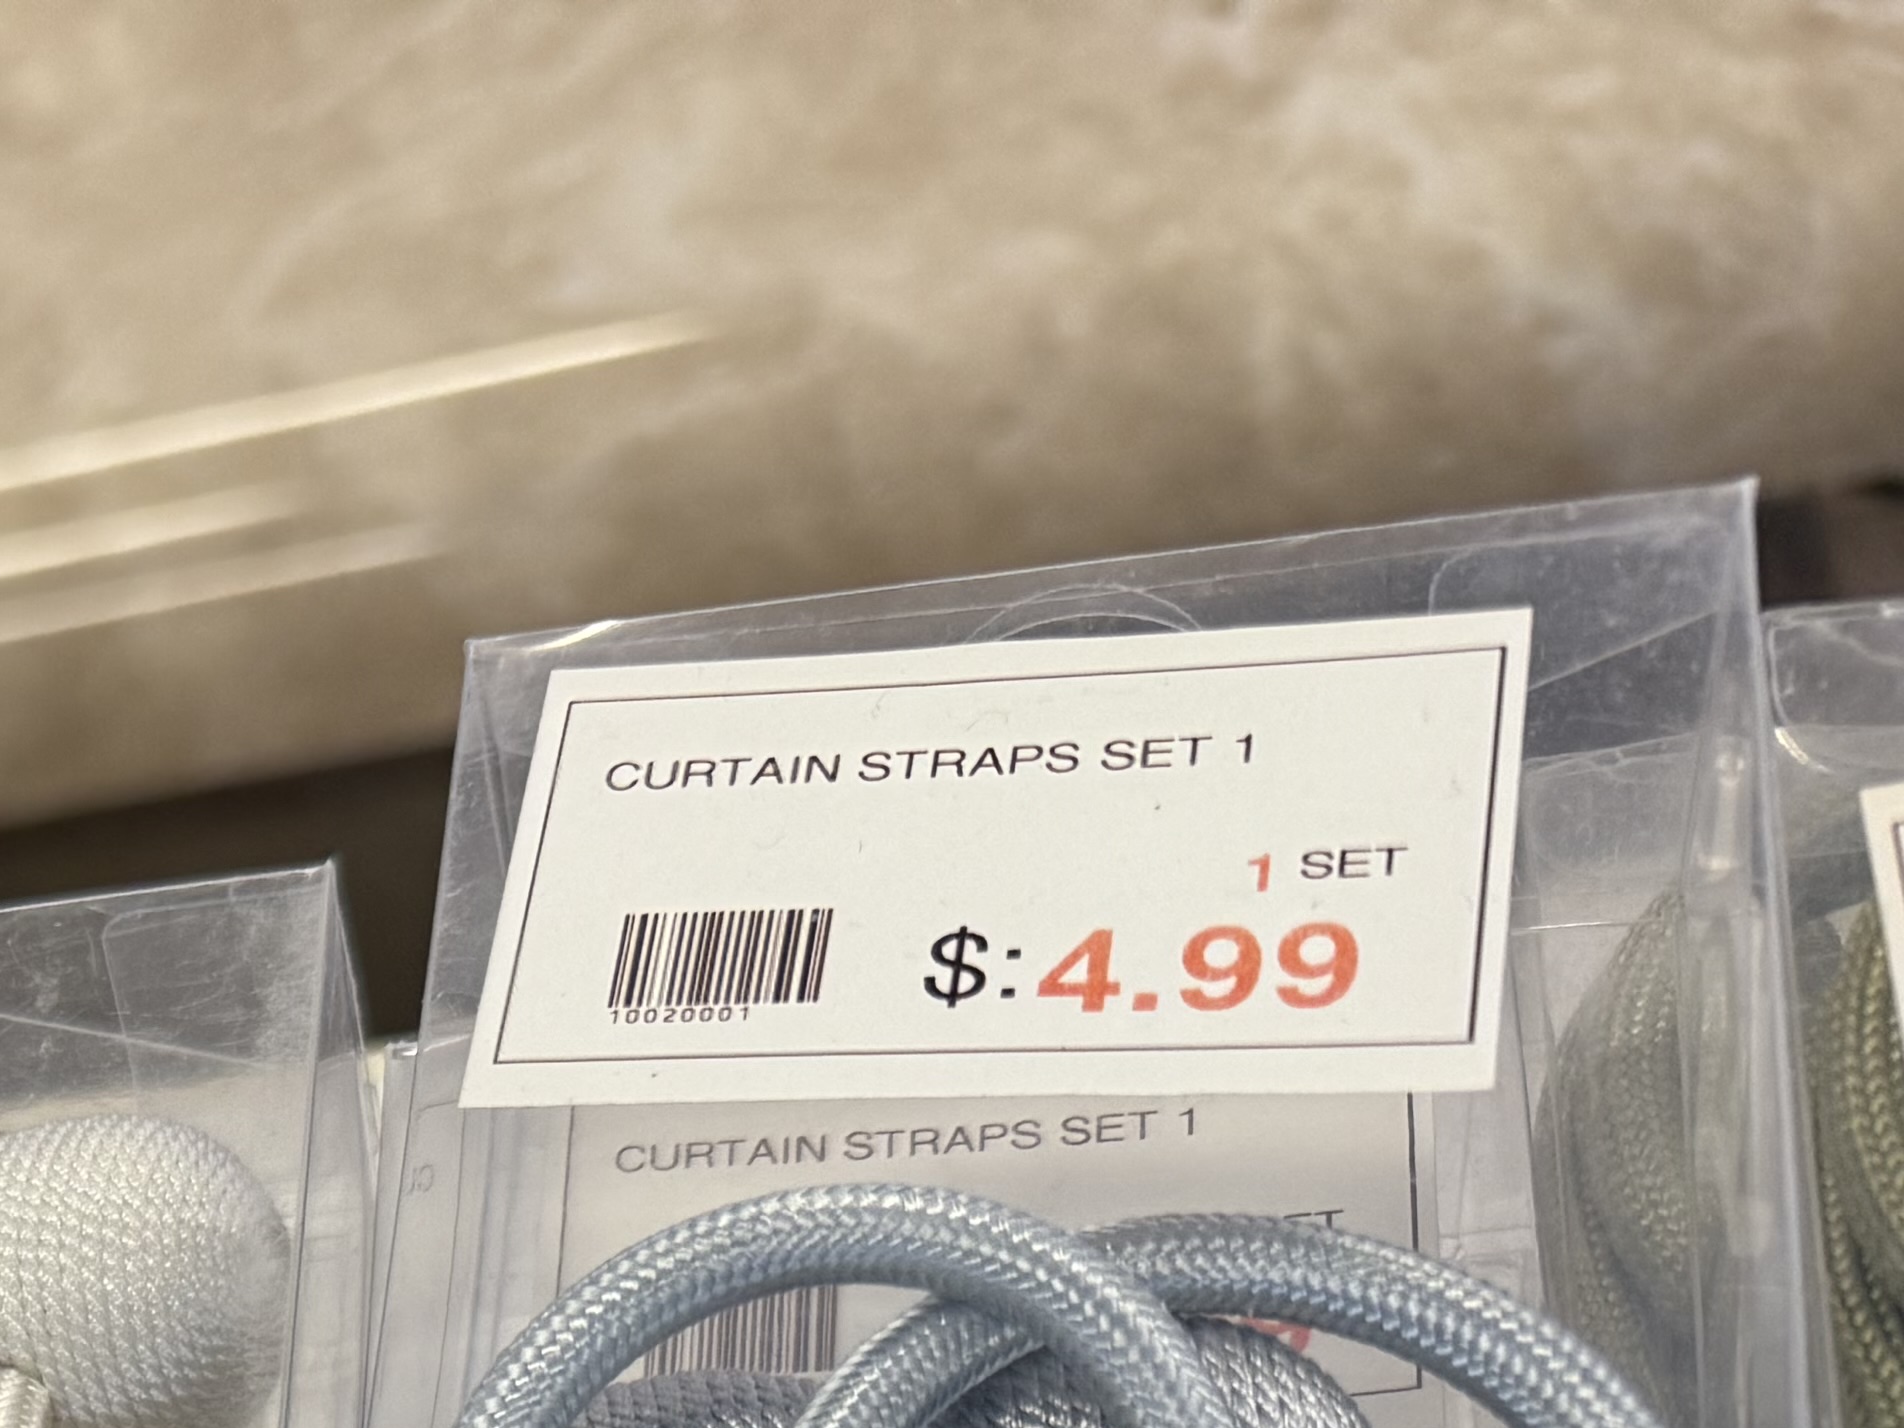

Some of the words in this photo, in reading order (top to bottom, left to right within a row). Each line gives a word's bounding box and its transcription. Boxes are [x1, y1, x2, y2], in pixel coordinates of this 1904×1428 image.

[604, 752, 841, 792] CURTAIN
[856, 742, 1081, 781] STRAPS
[1099, 735, 1214, 771] SET
[1234, 733, 1255, 764] 1
[1247, 852, 1272, 893] 1
[1299, 844, 1409, 880] SET
[609, 1005, 751, 1025] 10020001
[614, 1134, 828, 1174] CURTAIN
[842, 1120, 1043, 1161] STRAPS
[1059, 1109, 1160, 1148] SET
[1177, 1107, 1198, 1138] 1
